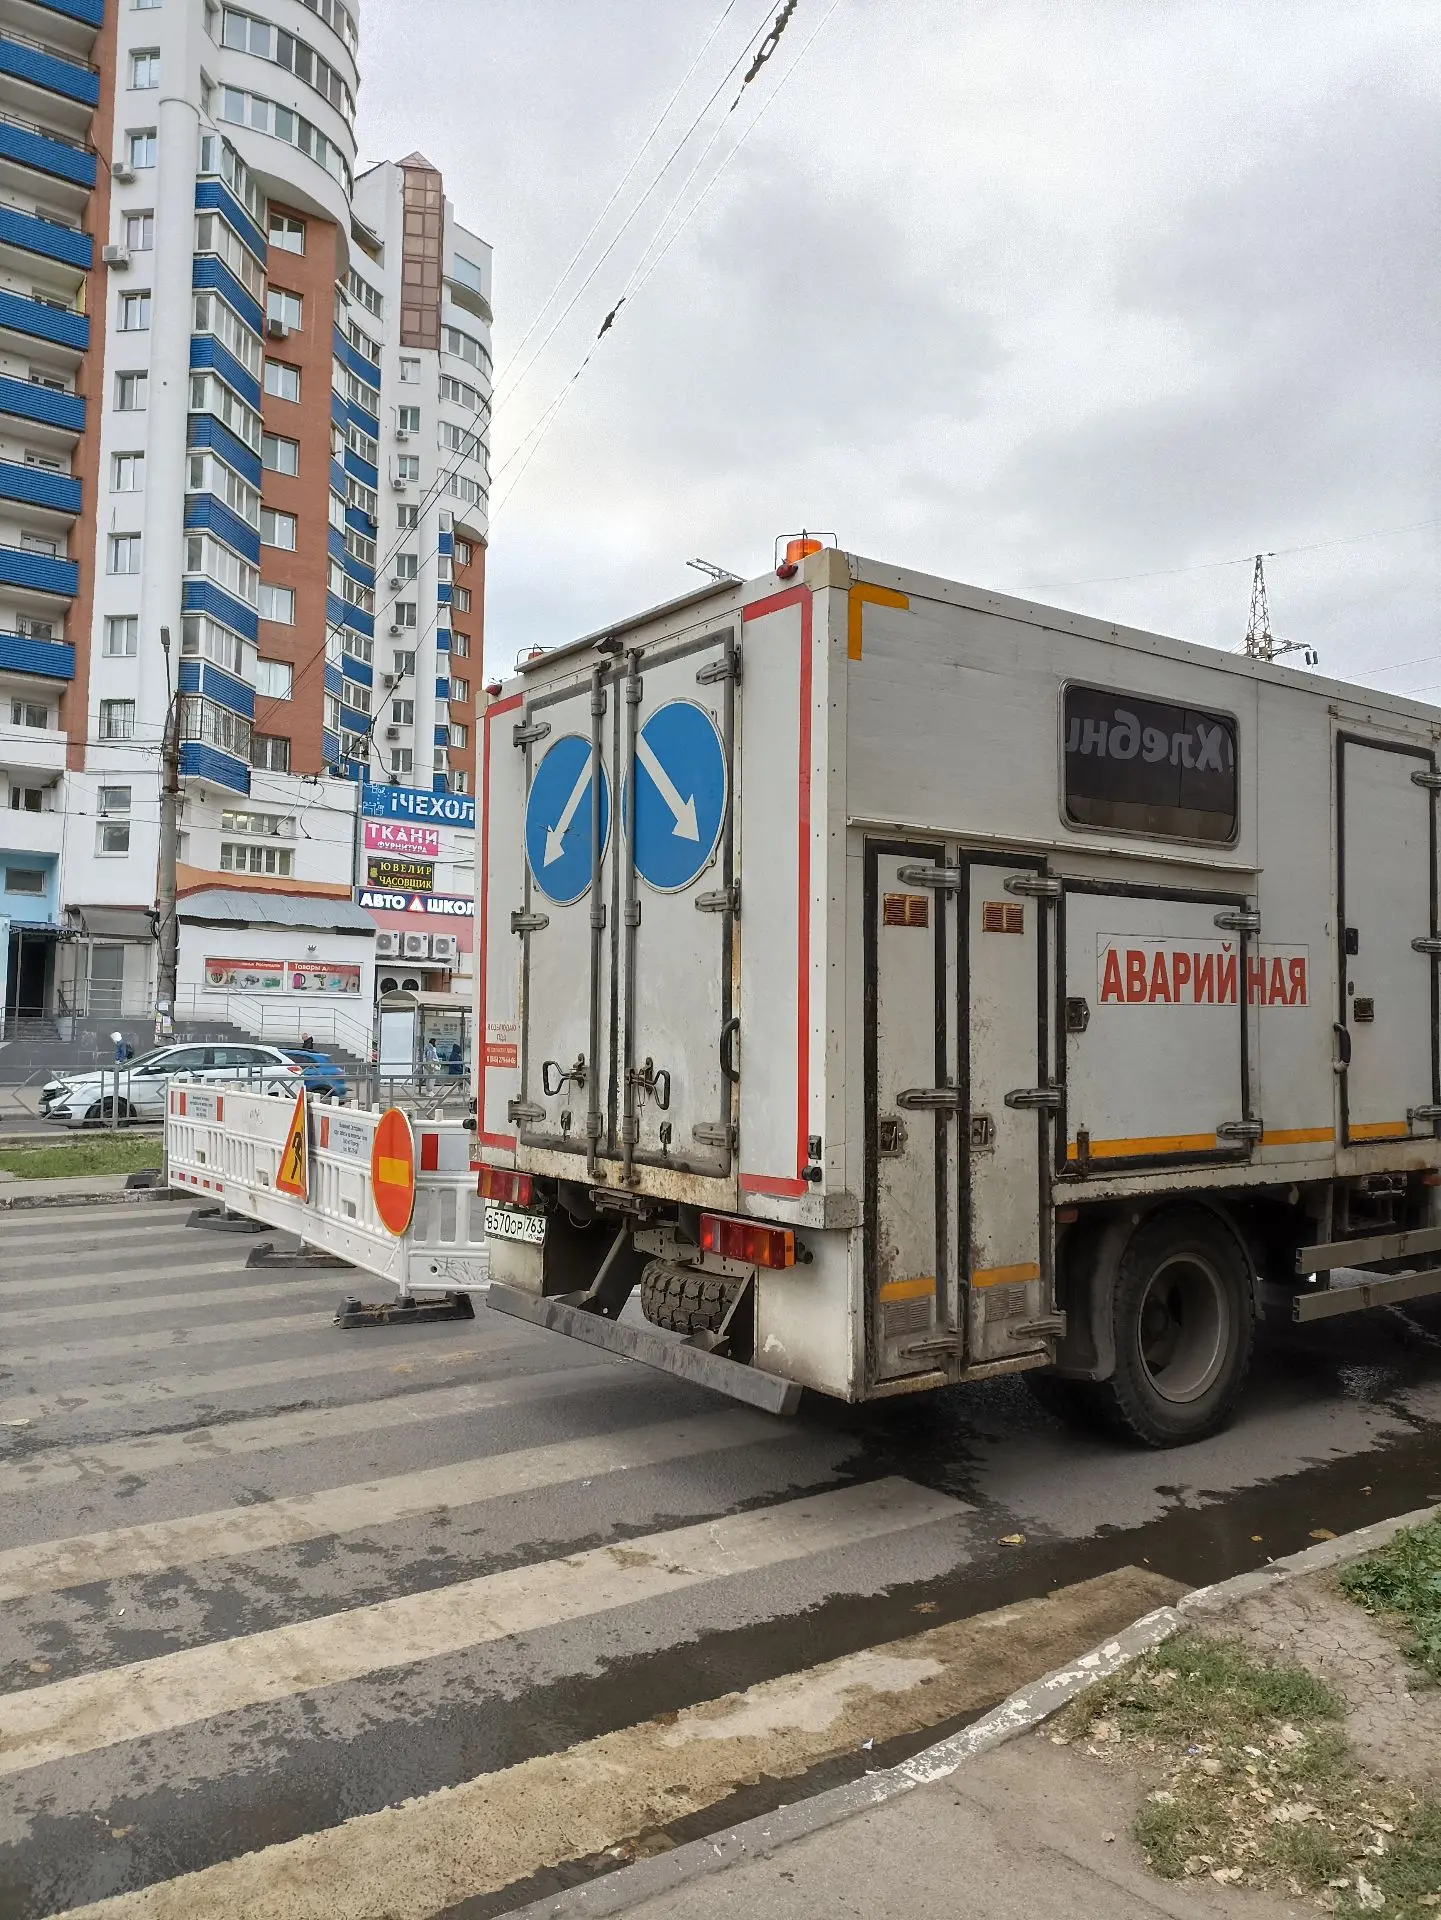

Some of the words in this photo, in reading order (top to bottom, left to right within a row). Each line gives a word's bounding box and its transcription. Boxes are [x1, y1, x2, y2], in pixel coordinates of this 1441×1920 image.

[367, 823, 438, 846] ТКАНИ
[377, 841, 428, 854] ФУРНИТУРА
[380, 861, 432, 875] ЮВЕЛИР
[379, 875, 432, 889] ЧАСОВЩИК
[360, 892, 406, 910] АВТО
[294, 963, 321, 972] Товары
[525, 1216, 544, 1235] 763
